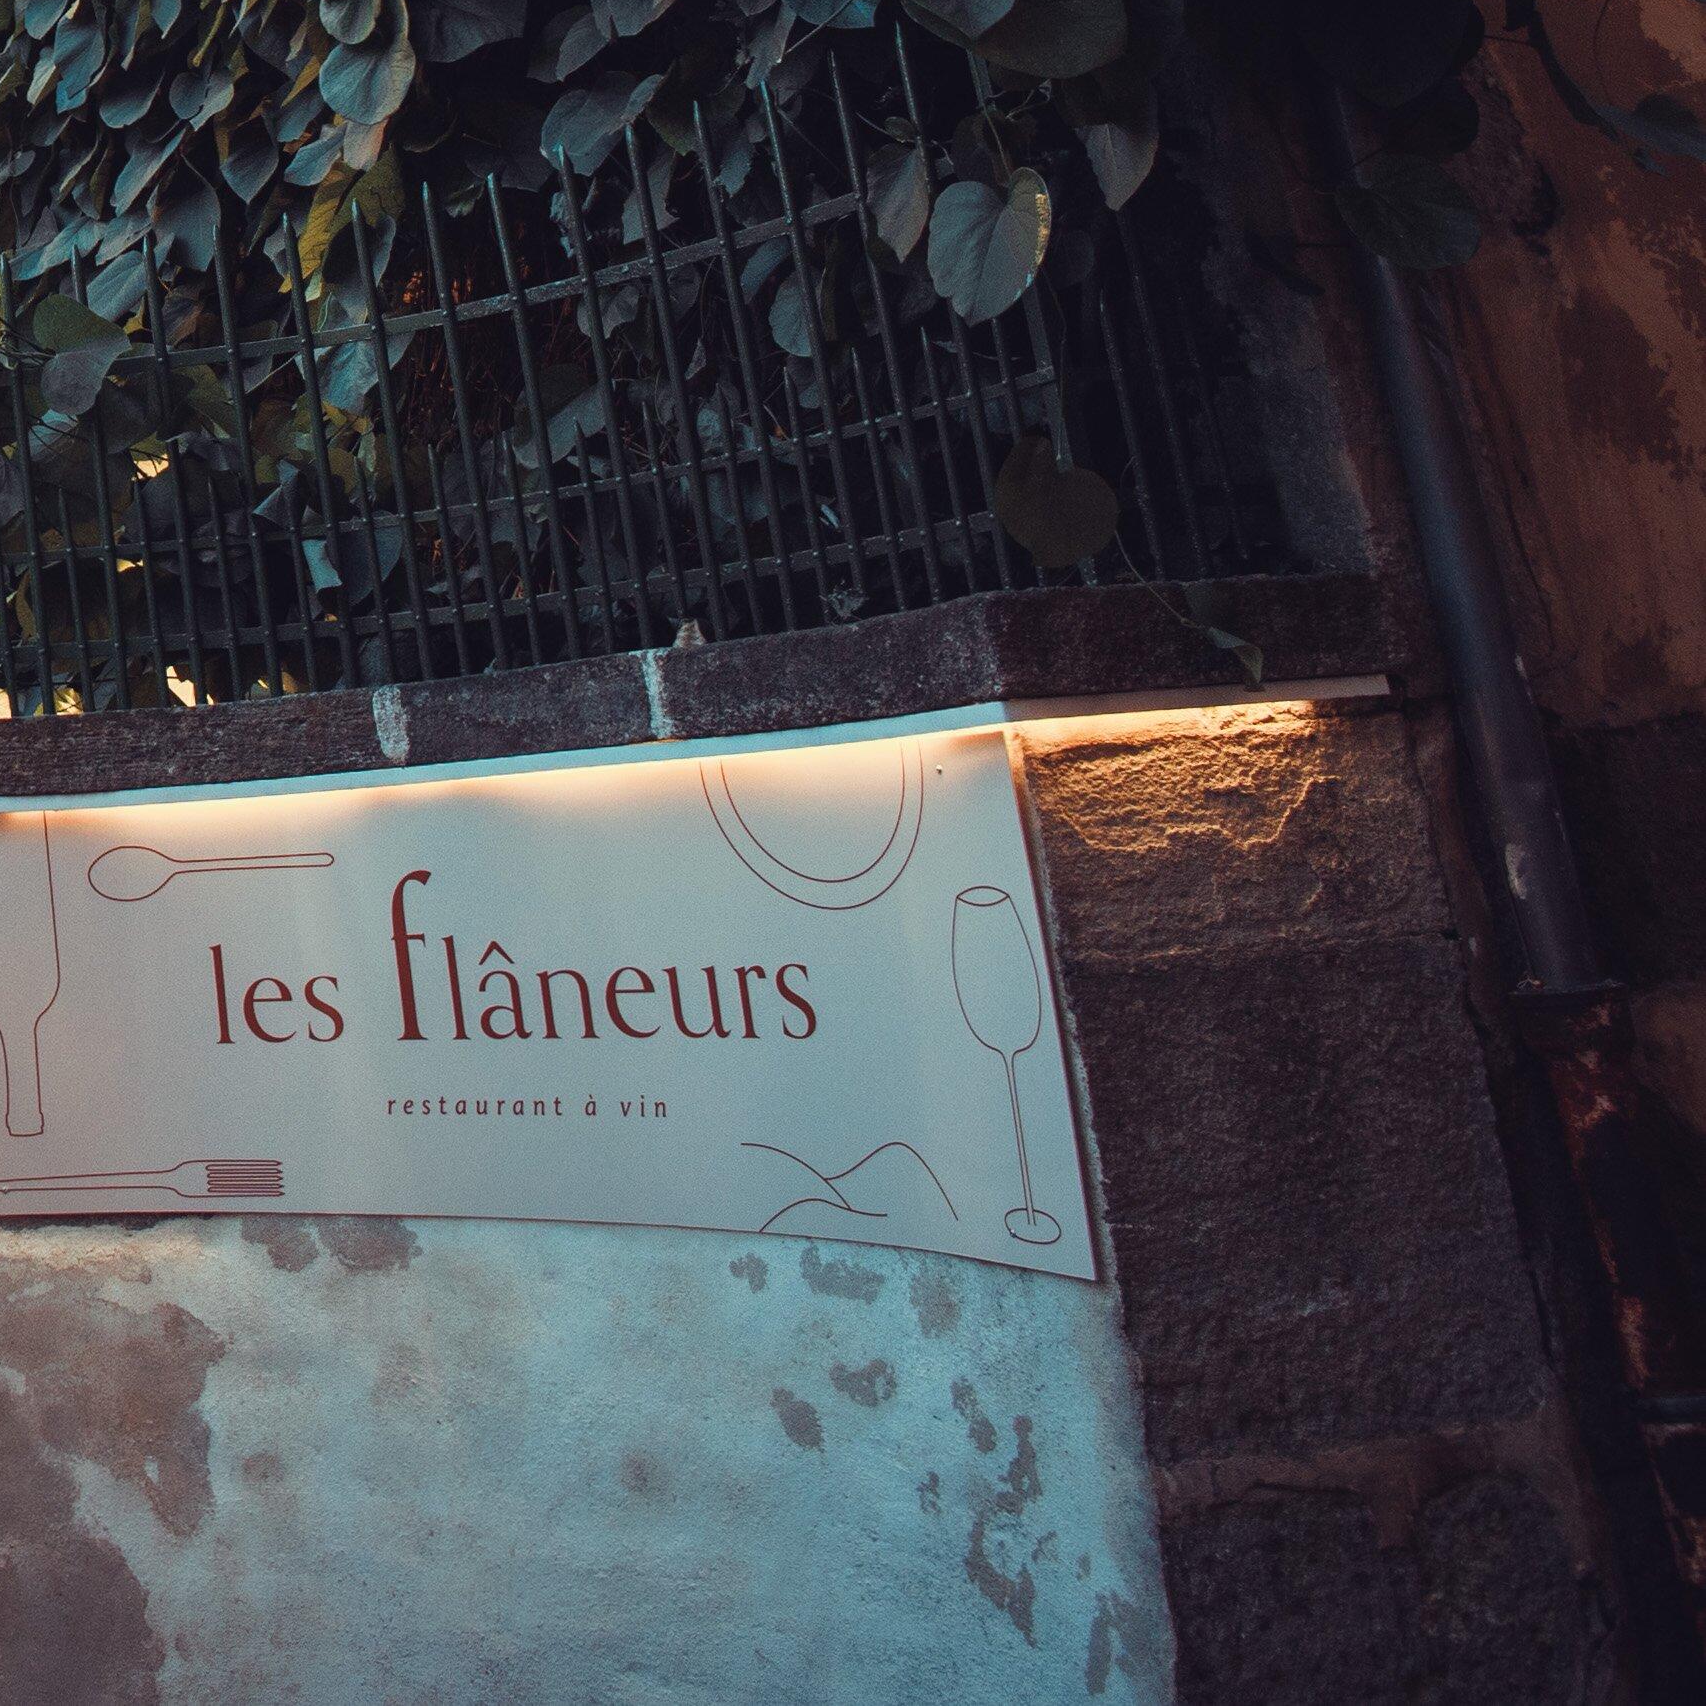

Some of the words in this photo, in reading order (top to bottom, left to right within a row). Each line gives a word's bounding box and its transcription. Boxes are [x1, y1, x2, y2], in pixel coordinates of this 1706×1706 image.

[208, 943, 346, 1045] les
[389, 867, 819, 1042] flâneurs
[386, 1095, 563, 1117] restaurant
[584, 1092, 598, 1118] à
[619, 1093, 668, 1119] vin
